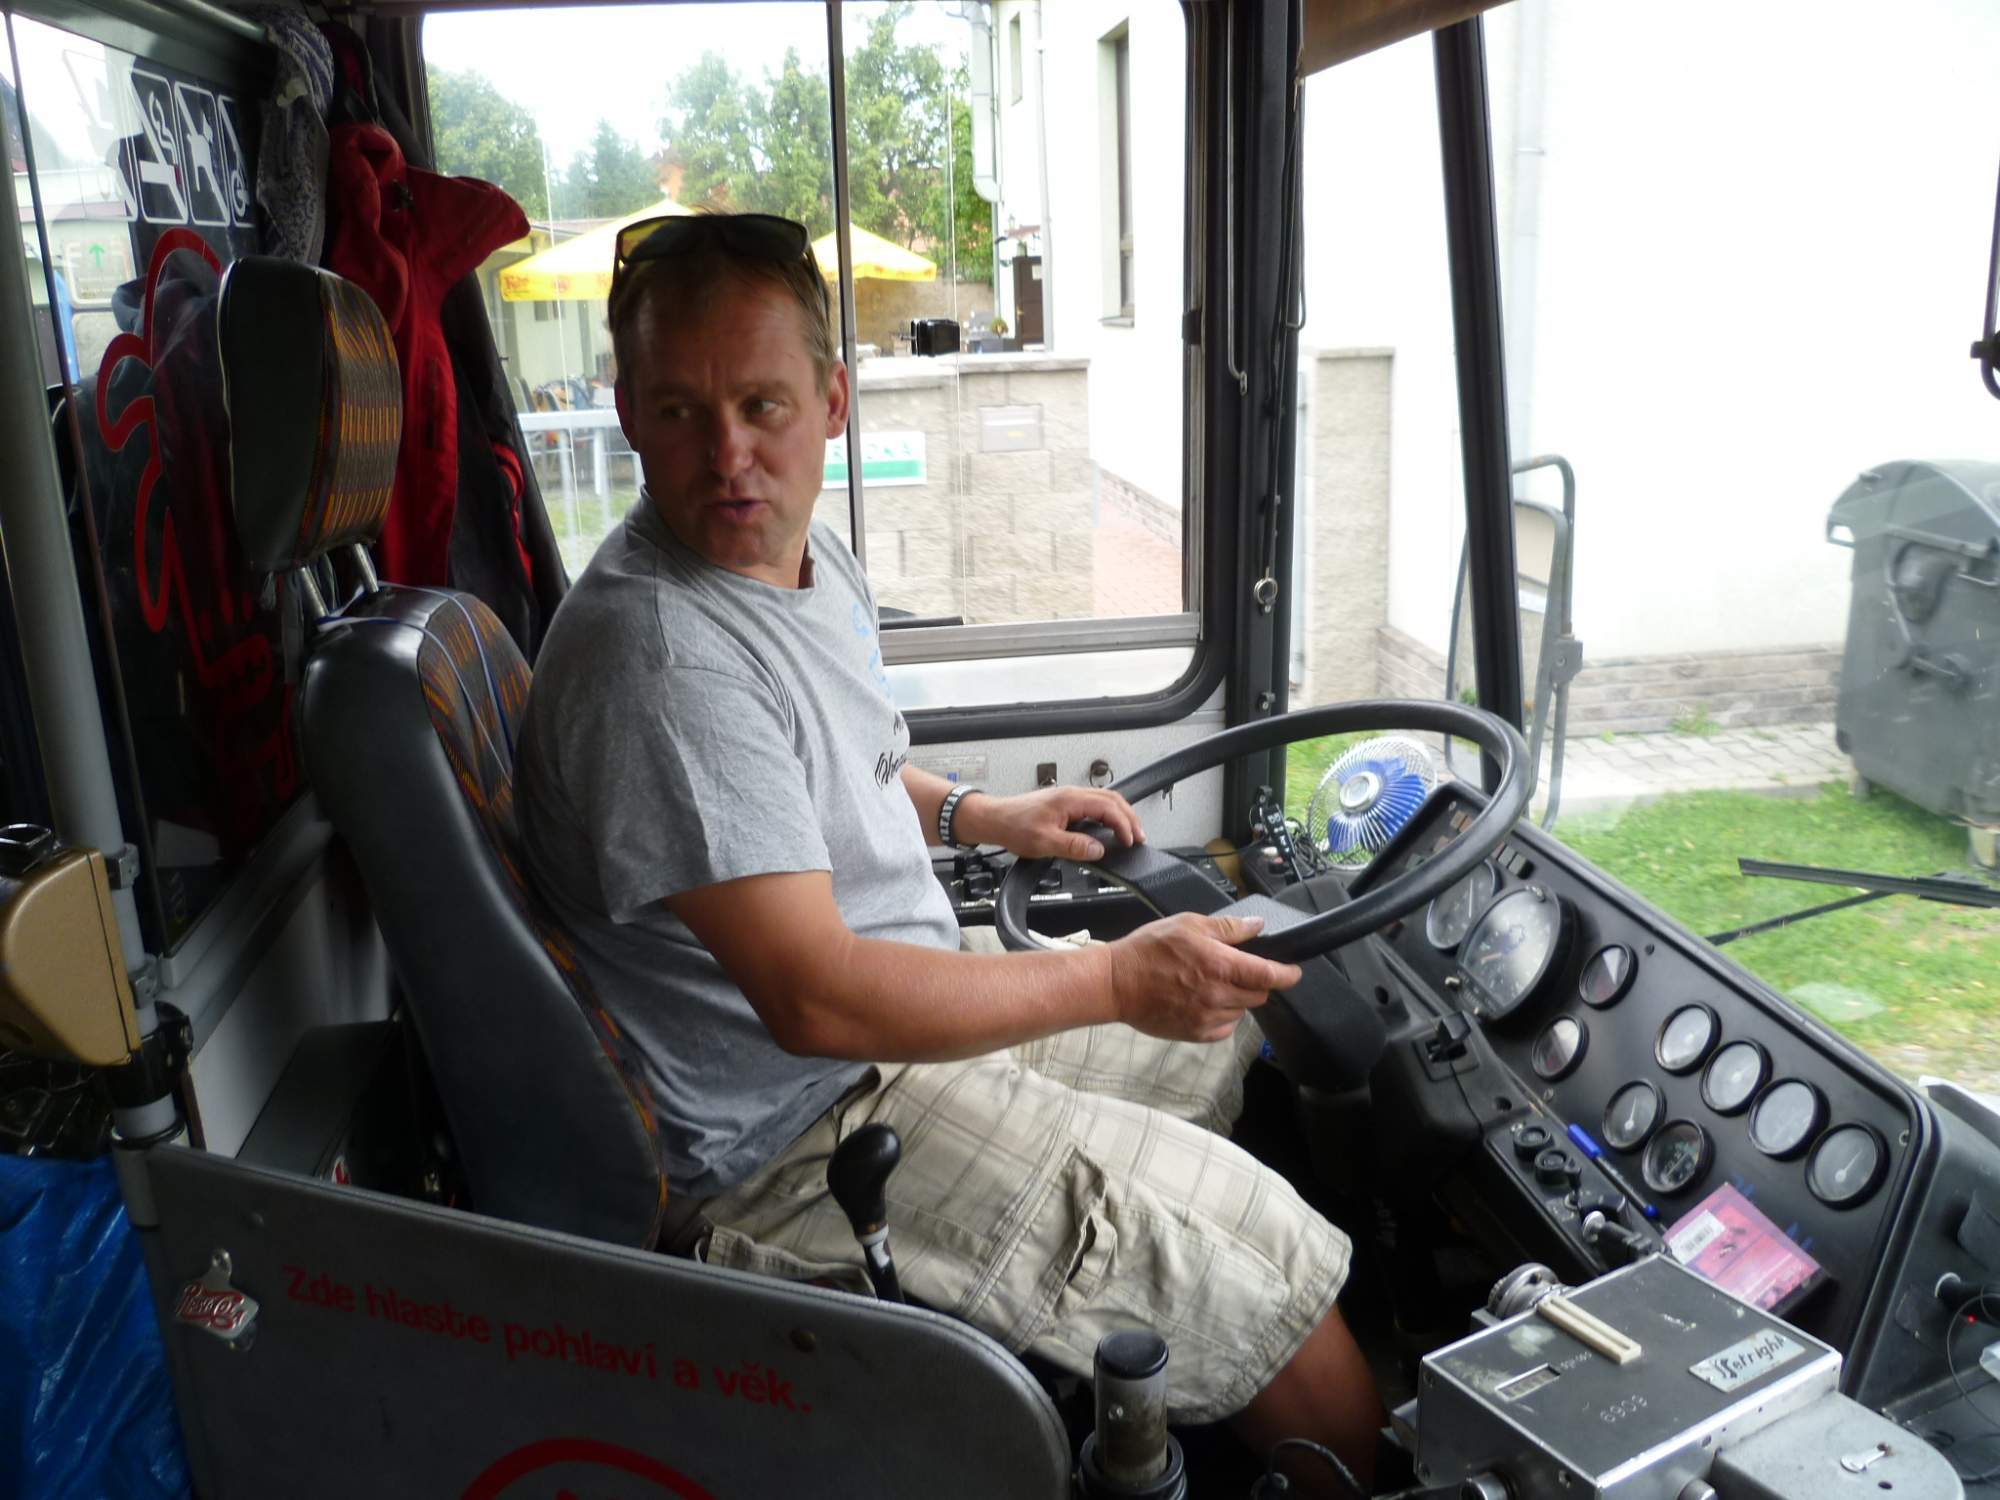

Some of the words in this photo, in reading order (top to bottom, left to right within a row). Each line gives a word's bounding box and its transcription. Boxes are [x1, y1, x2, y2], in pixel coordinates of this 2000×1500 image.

[282, 1265, 355, 1314] Zde
[365, 1285, 492, 1346] hlaste
[504, 1322, 658, 1380] pohlaví
[672, 1359, 702, 1391] a
[713, 1361, 812, 1415] věk.
